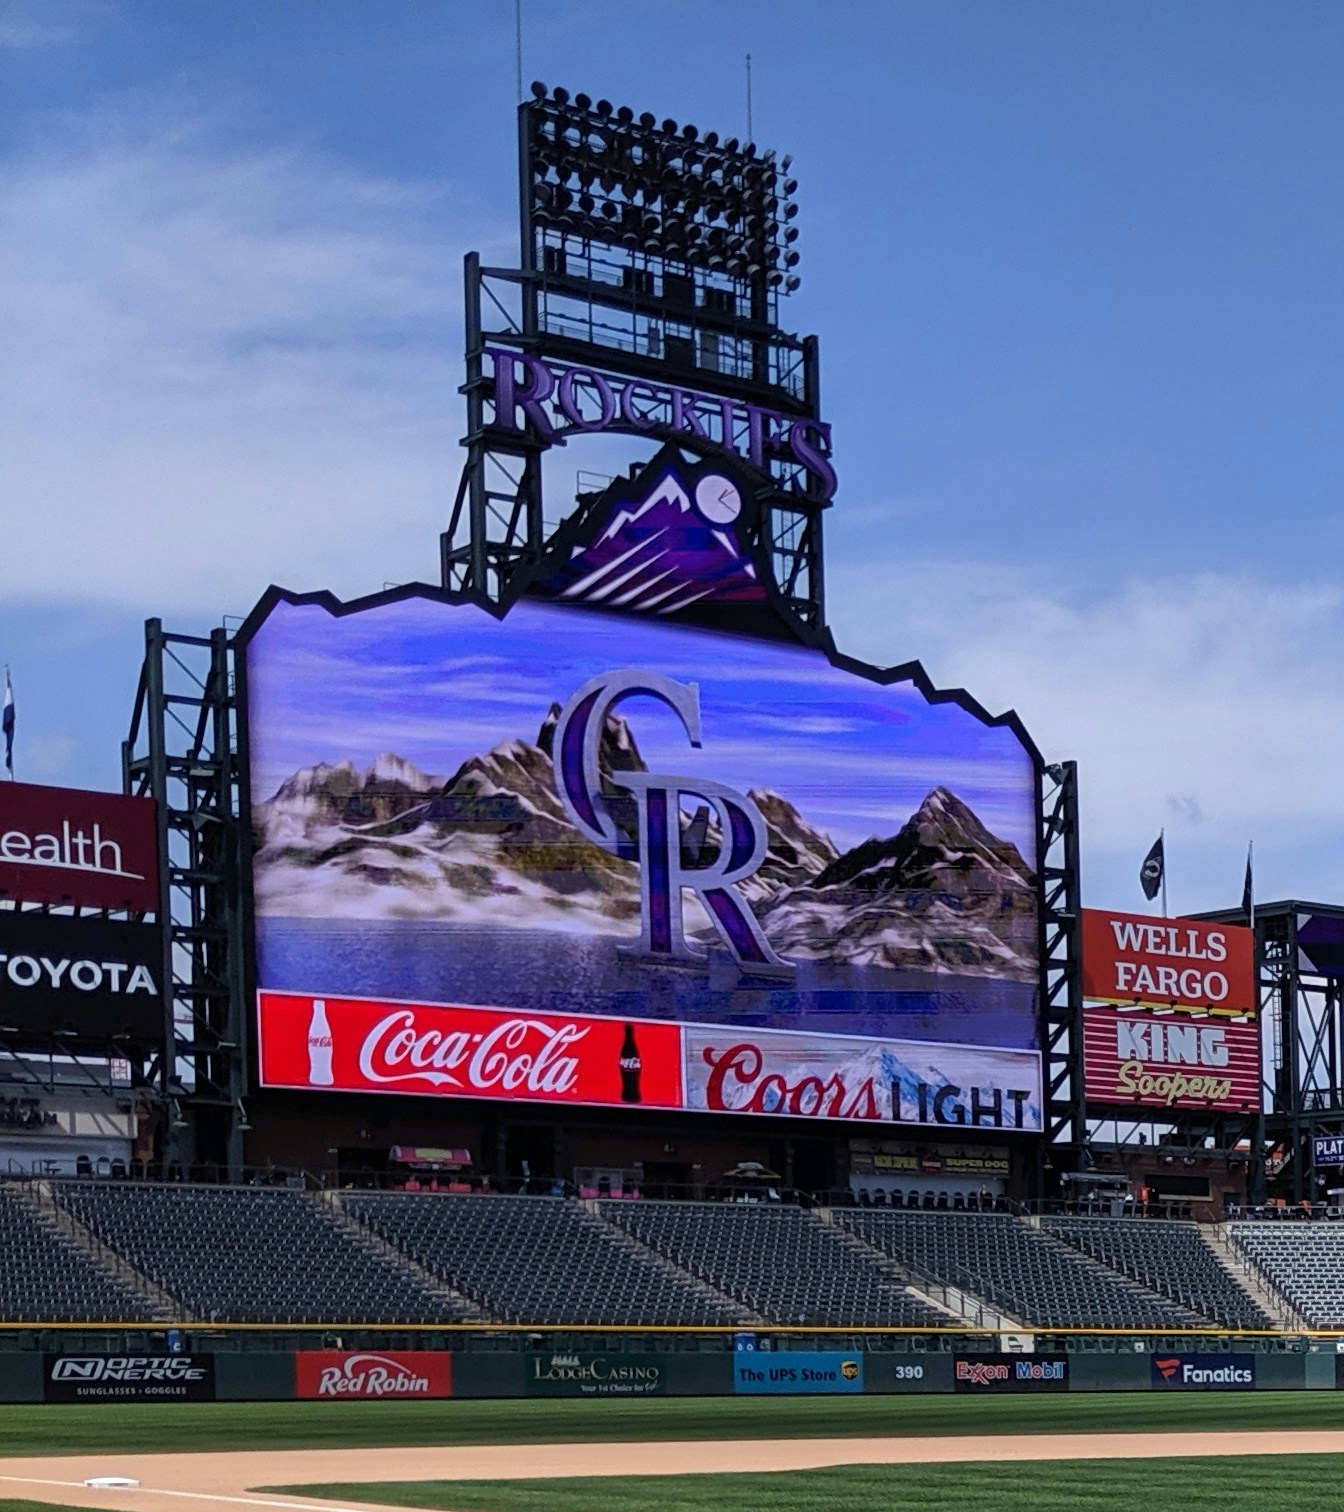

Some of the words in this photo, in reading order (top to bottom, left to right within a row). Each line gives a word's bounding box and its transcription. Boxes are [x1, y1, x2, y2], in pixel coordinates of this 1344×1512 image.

[483, 347, 838, 500] ROCKIES
[0, 820, 123, 873] ealth
[1110, 920, 1227, 962] WELLS
[1115, 961, 1229, 1001] FARGO
[359, 1010, 591, 1094] Coca-Cola
[1116, 1020, 1229, 1067] KING
[703, 1043, 882, 1120] Coors
[891, 1080, 1032, 1129] LIGHT
[1116, 1060, 1232, 1105] Soopers
[946, 1158, 983, 1168] SUPER
[984, 1160, 1008, 1169] DOG
[101, 1368, 206, 1380] NERVE
[107, 1357, 192, 1369] OPTIC
[740, 1368, 765, 1382] The
[770, 1368, 797, 1382] UPS
[801, 1368, 837, 1382] Store
[895, 1366, 924, 1379] 390
[956, 1361, 1009, 1385] Exxon
[1016, 1361, 1064, 1379] Mobil
[1183, 1364, 1252, 1383] Fanatics
[77, 1387, 136, 1395] SUNGLASSES
[144, 1386, 187, 1395] GOGGLES
[319, 1367, 365, 1396] Red
[366, 1367, 428, 1396] Robin
